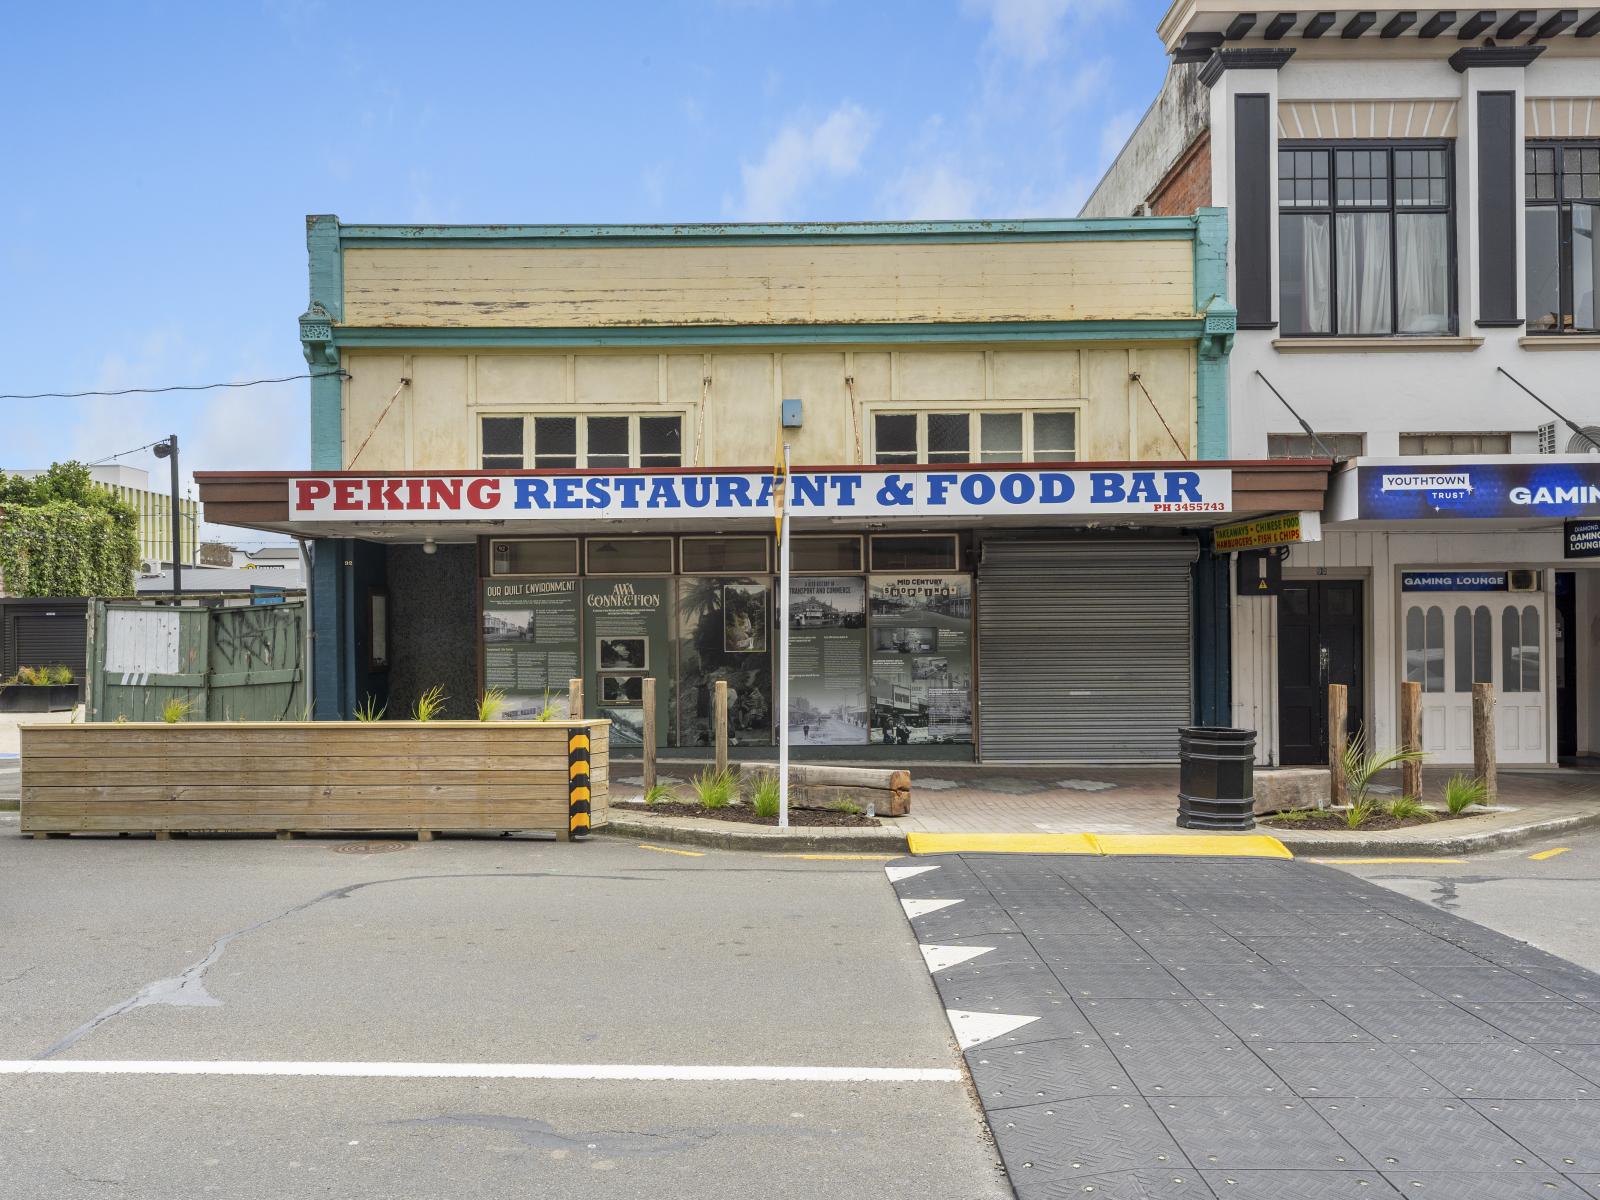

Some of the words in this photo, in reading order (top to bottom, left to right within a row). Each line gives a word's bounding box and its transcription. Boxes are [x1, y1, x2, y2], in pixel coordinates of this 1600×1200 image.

[1387, 476, 1465, 486] YOUTHTOWN
[295, 478, 501, 510] PEKING
[514, 475, 861, 509] RESTAURANT
[876, 474, 913, 506] &
[927, 473, 1075, 505] FOOD
[1090, 471, 1203, 504] BAR
[1509, 486, 1600, 505] GAMIN
[1153, 503, 1171, 511] PH
[1174, 502, 1225, 511] 3455743
[1216, 525, 1248, 539] TAKEAWAYS
[1255, 519, 1281, 533] CHINESE
[1283, 517, 1299, 528] FOOD
[1574, 525, 1599, 533] DIAMOND
[1216, 536, 1253, 549] HAMBURGERS
[1258, 533, 1272, 544] FISH
[1279, 529, 1300, 541] CHIPS
[1404, 577, 1452, 585] GAMING
[1456, 577, 1504, 585] LOUNGE
[487, 586, 502, 597] OUR
[504, 584, 523, 596] BUILT
[525, 581, 576, 594] ENVIRONMENT
[789, 587, 815, 595] TRANSPORT
[816, 586, 826, 594] AND
[826, 586, 851, 594] COMMERCE
[884, 586, 949, 596] SHOPPING
[587, 594, 660, 607] CONNECTION
